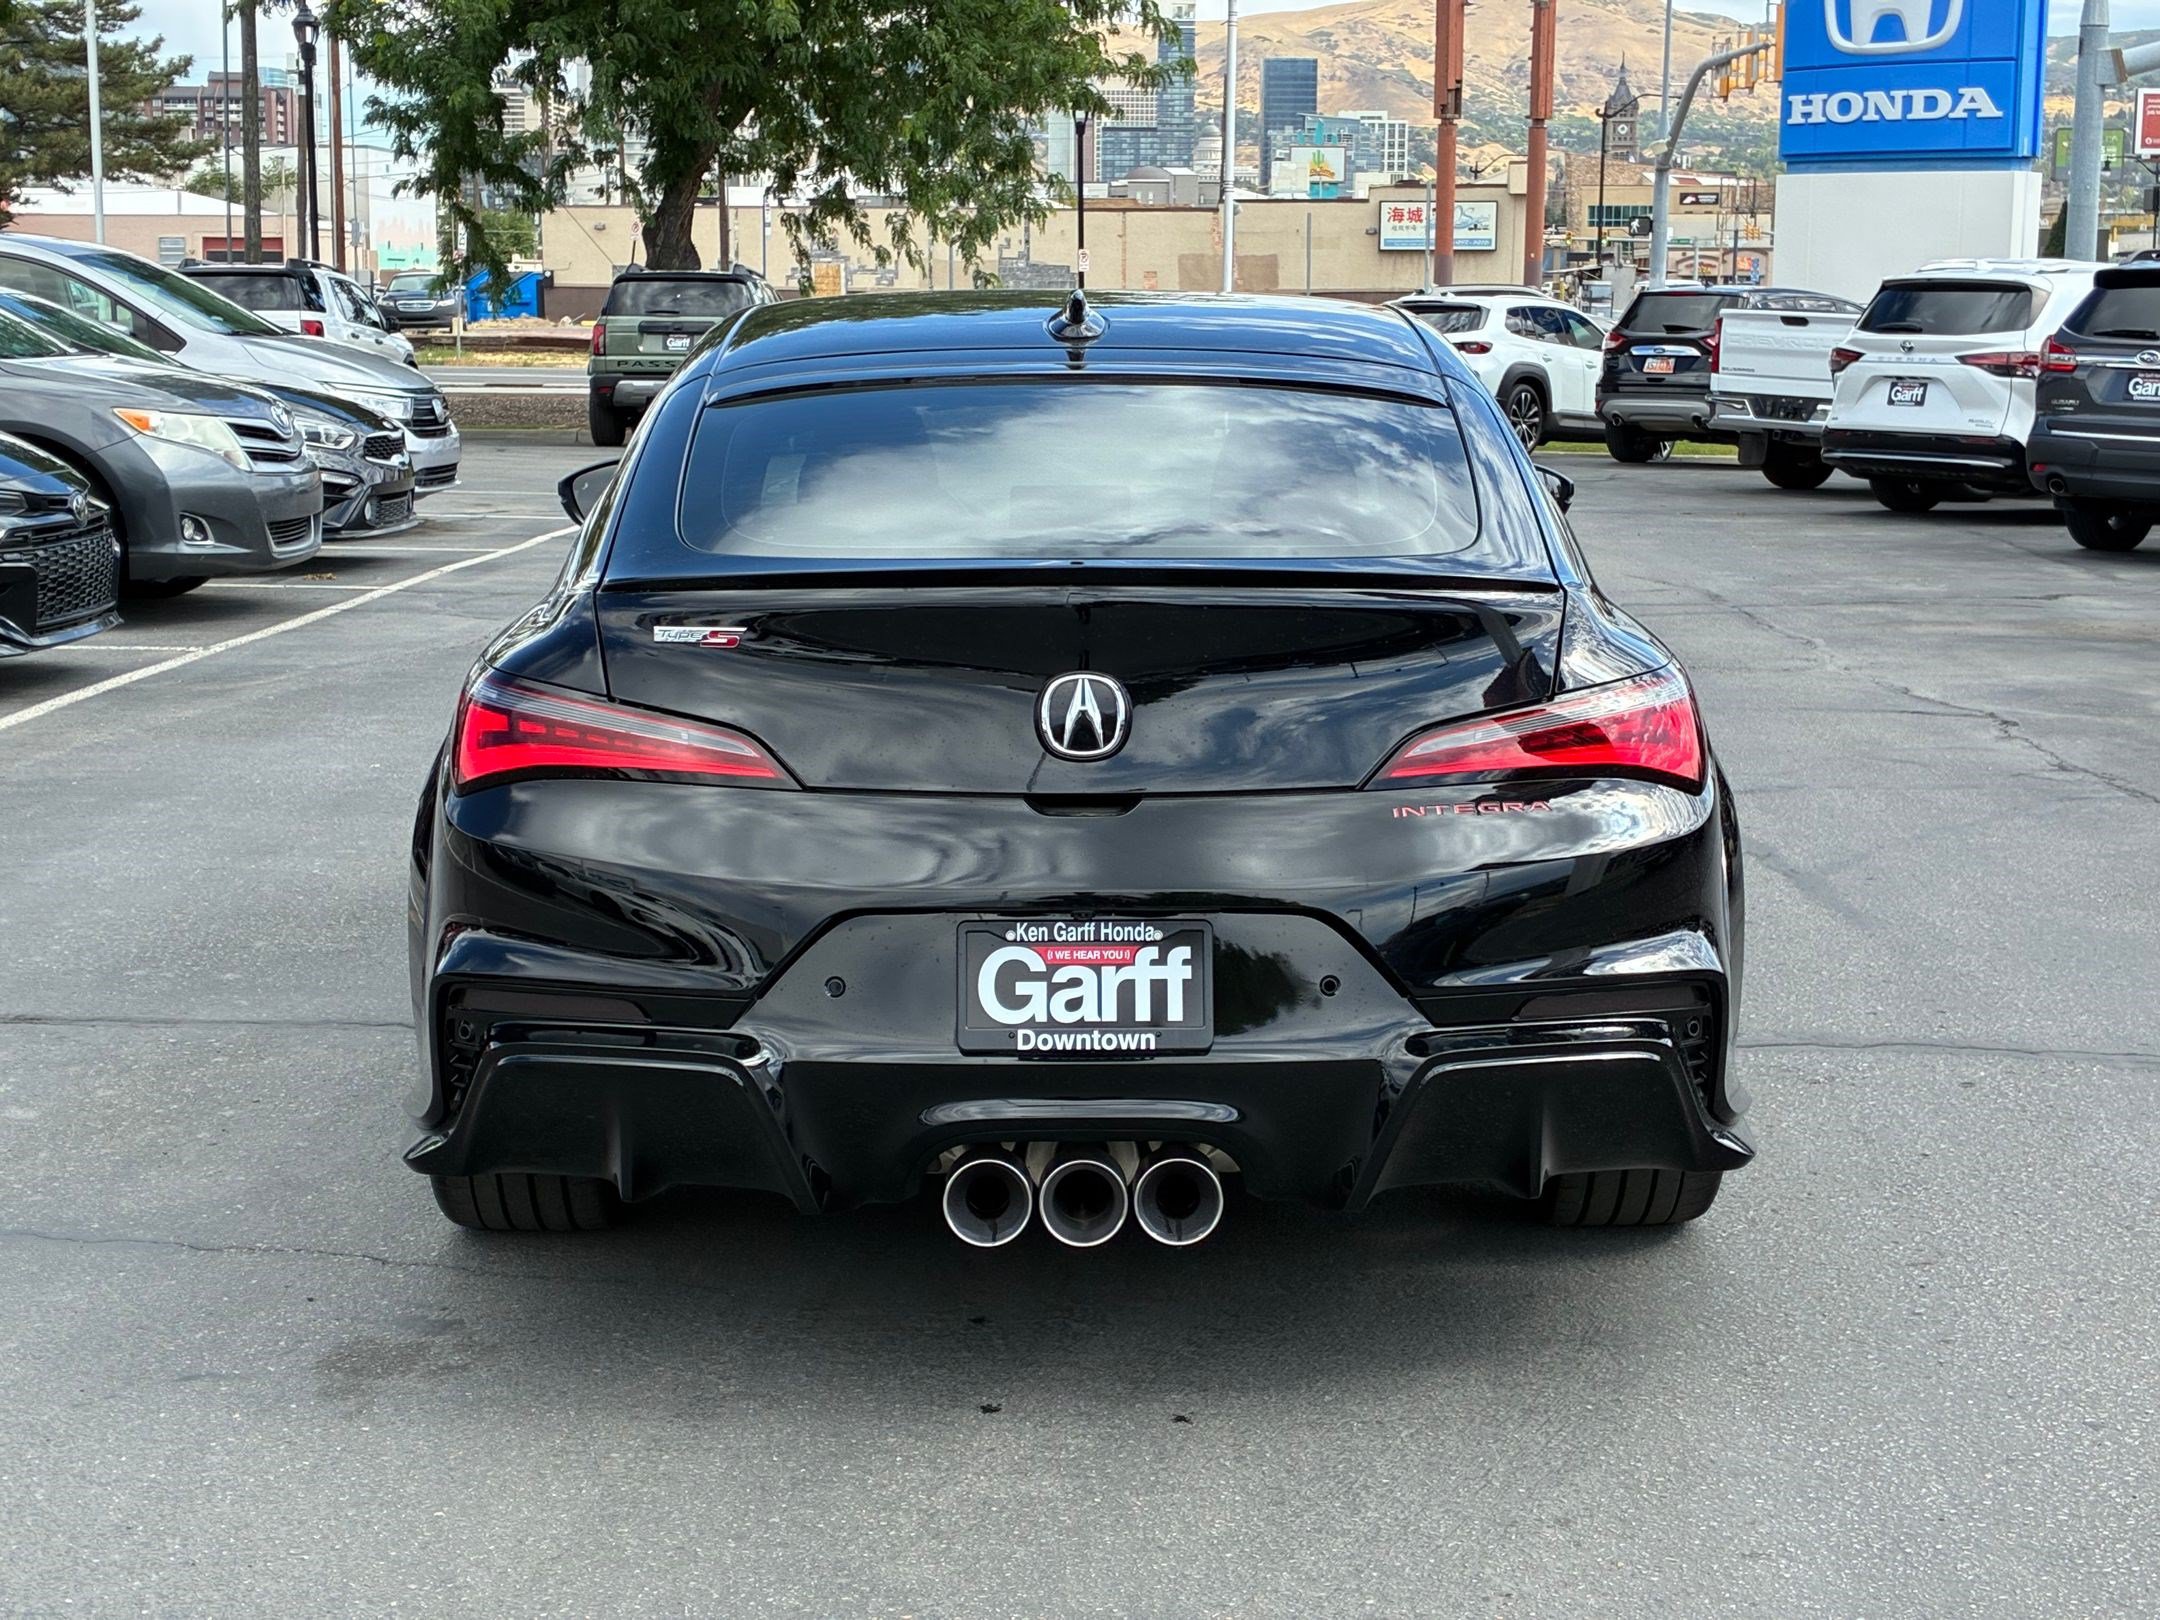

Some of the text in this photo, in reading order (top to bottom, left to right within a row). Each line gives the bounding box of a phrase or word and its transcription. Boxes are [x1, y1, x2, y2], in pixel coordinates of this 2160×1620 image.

[1787, 87, 2004, 125] HONDA
[1387, 206, 1424, 224] 海城
[617, 360, 677, 368] PASS
[1890, 385, 1924, 402] Garff
[2128, 377, 2160, 397] Gar
[700, 629, 741, 648] S
[1392, 801, 1553, 818] INTEGRA
[1016, 921, 1155, 942] Ken Garff Honda
[1055, 950, 1124, 960] WE HEAR YOU
[977, 945, 1193, 1025] Garff
[1017, 1029, 1156, 1050] Downtown
